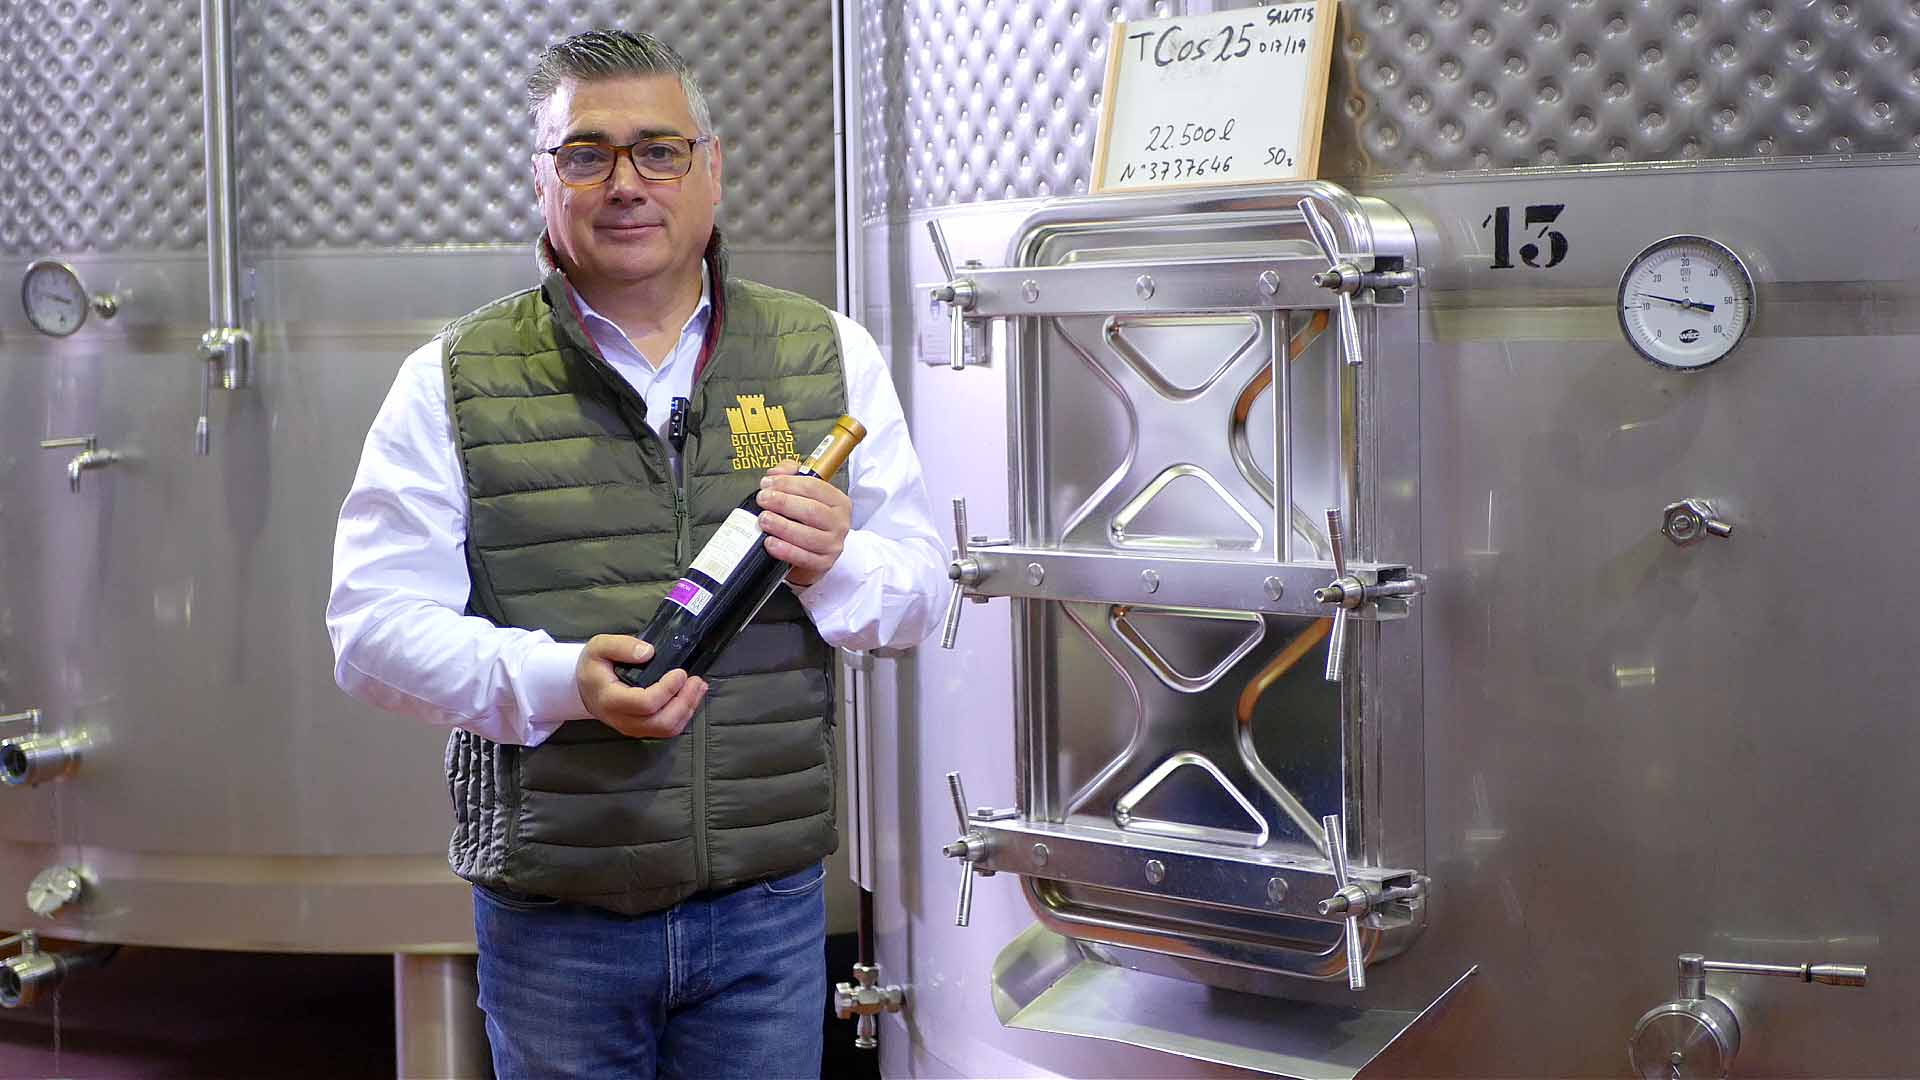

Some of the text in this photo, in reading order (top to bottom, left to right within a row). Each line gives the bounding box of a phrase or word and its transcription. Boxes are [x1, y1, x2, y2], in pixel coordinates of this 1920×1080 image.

[1482, 204, 1569, 269] 13
[1681, 258, 1690, 267] 30
[1709, 269, 1718, 277] 40
[1653, 274, 1662, 282] 20
[1724, 297, 1733, 305] 50
[1642, 302, 1650, 310] 10
[1657, 329, 1662, 337] 0
[731, 430, 794, 447] BODEGAS
[736, 442, 794, 458] SANTISO
